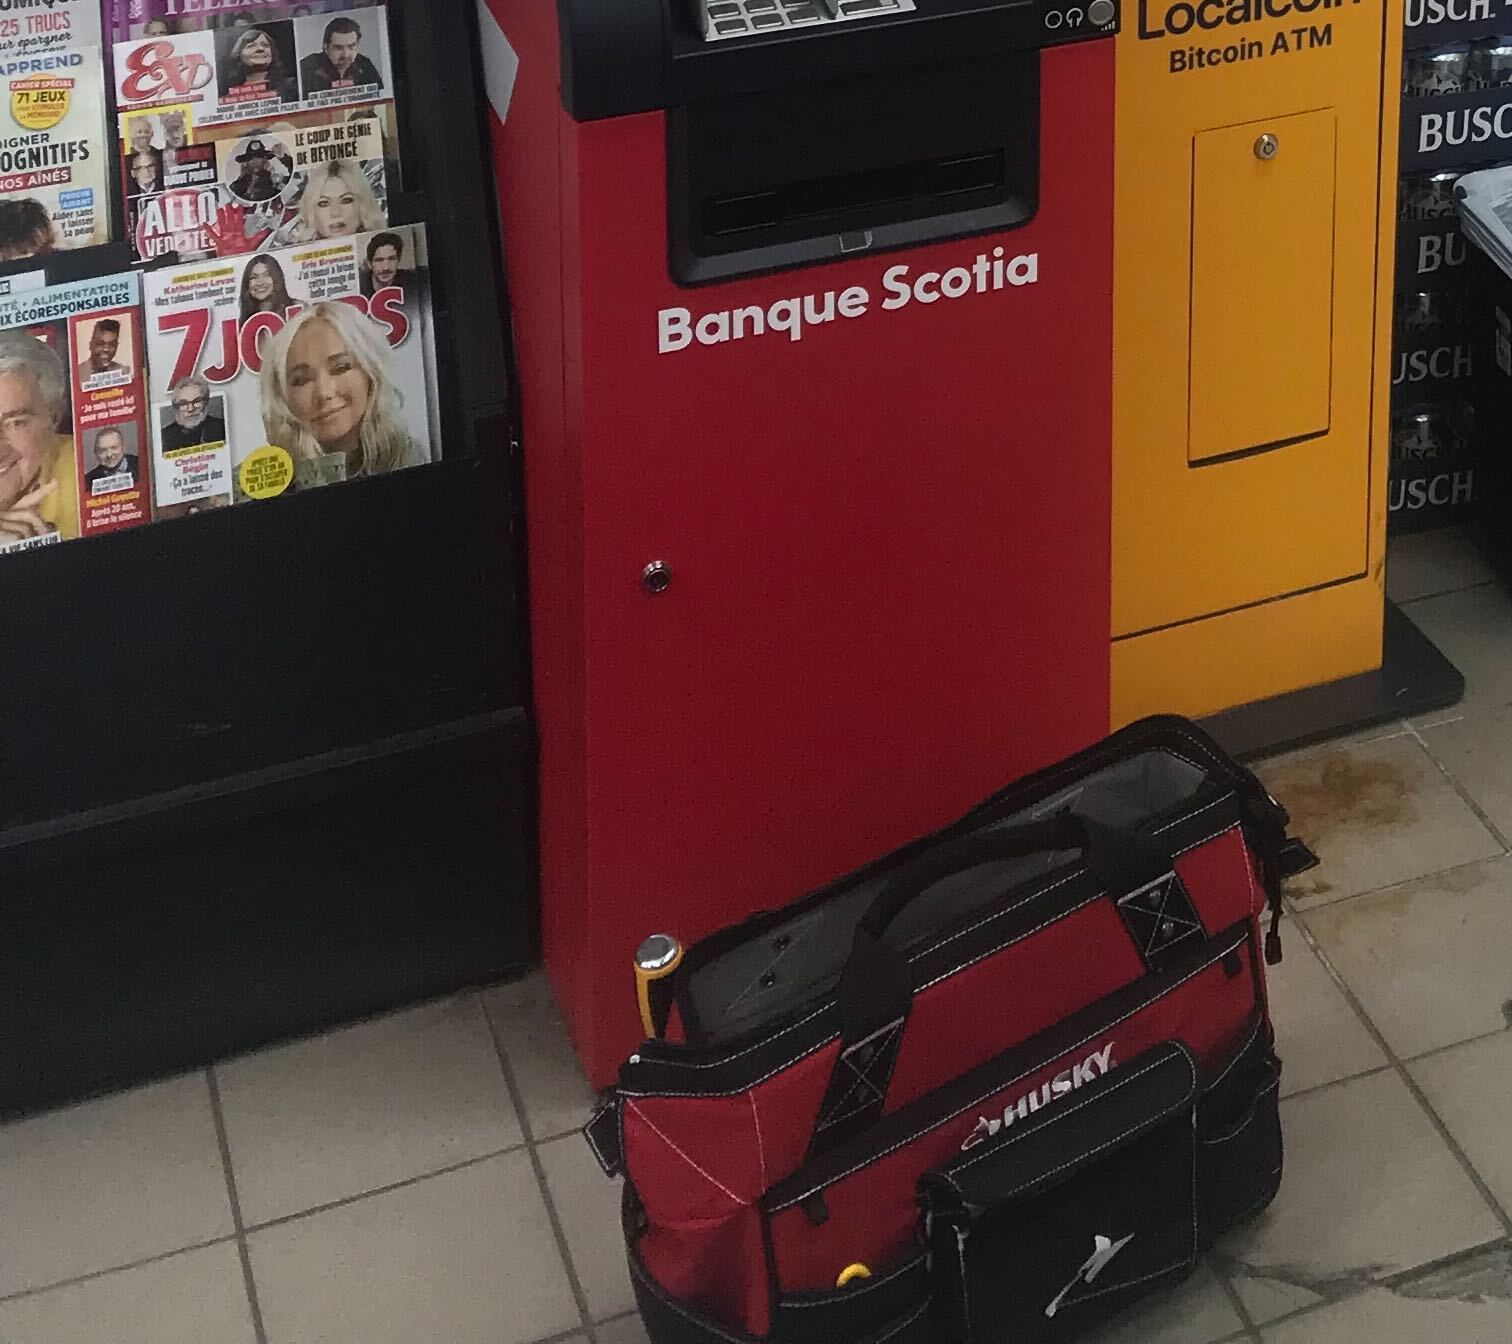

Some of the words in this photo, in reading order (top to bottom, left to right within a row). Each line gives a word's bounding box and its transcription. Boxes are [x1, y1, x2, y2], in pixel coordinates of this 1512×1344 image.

[25, 11, 71, 34] TRUCS
[1169, 40, 1265, 74] Bitcoin
[1270, 24, 1333, 55] ATM
[17, 92, 29, 104] 71
[33, 90, 66, 103] JEUX
[307, 129, 331, 145] COUP
[334, 128, 345, 142] DE
[16, 292, 130, 322] ÉCORESPONSABLES
[32, 282, 129, 307] ALIMENTATION
[657, 283, 870, 354] Banque
[881, 246, 1040, 310] Scotia
[1003, 1043, 1113, 1128] HUSKY
